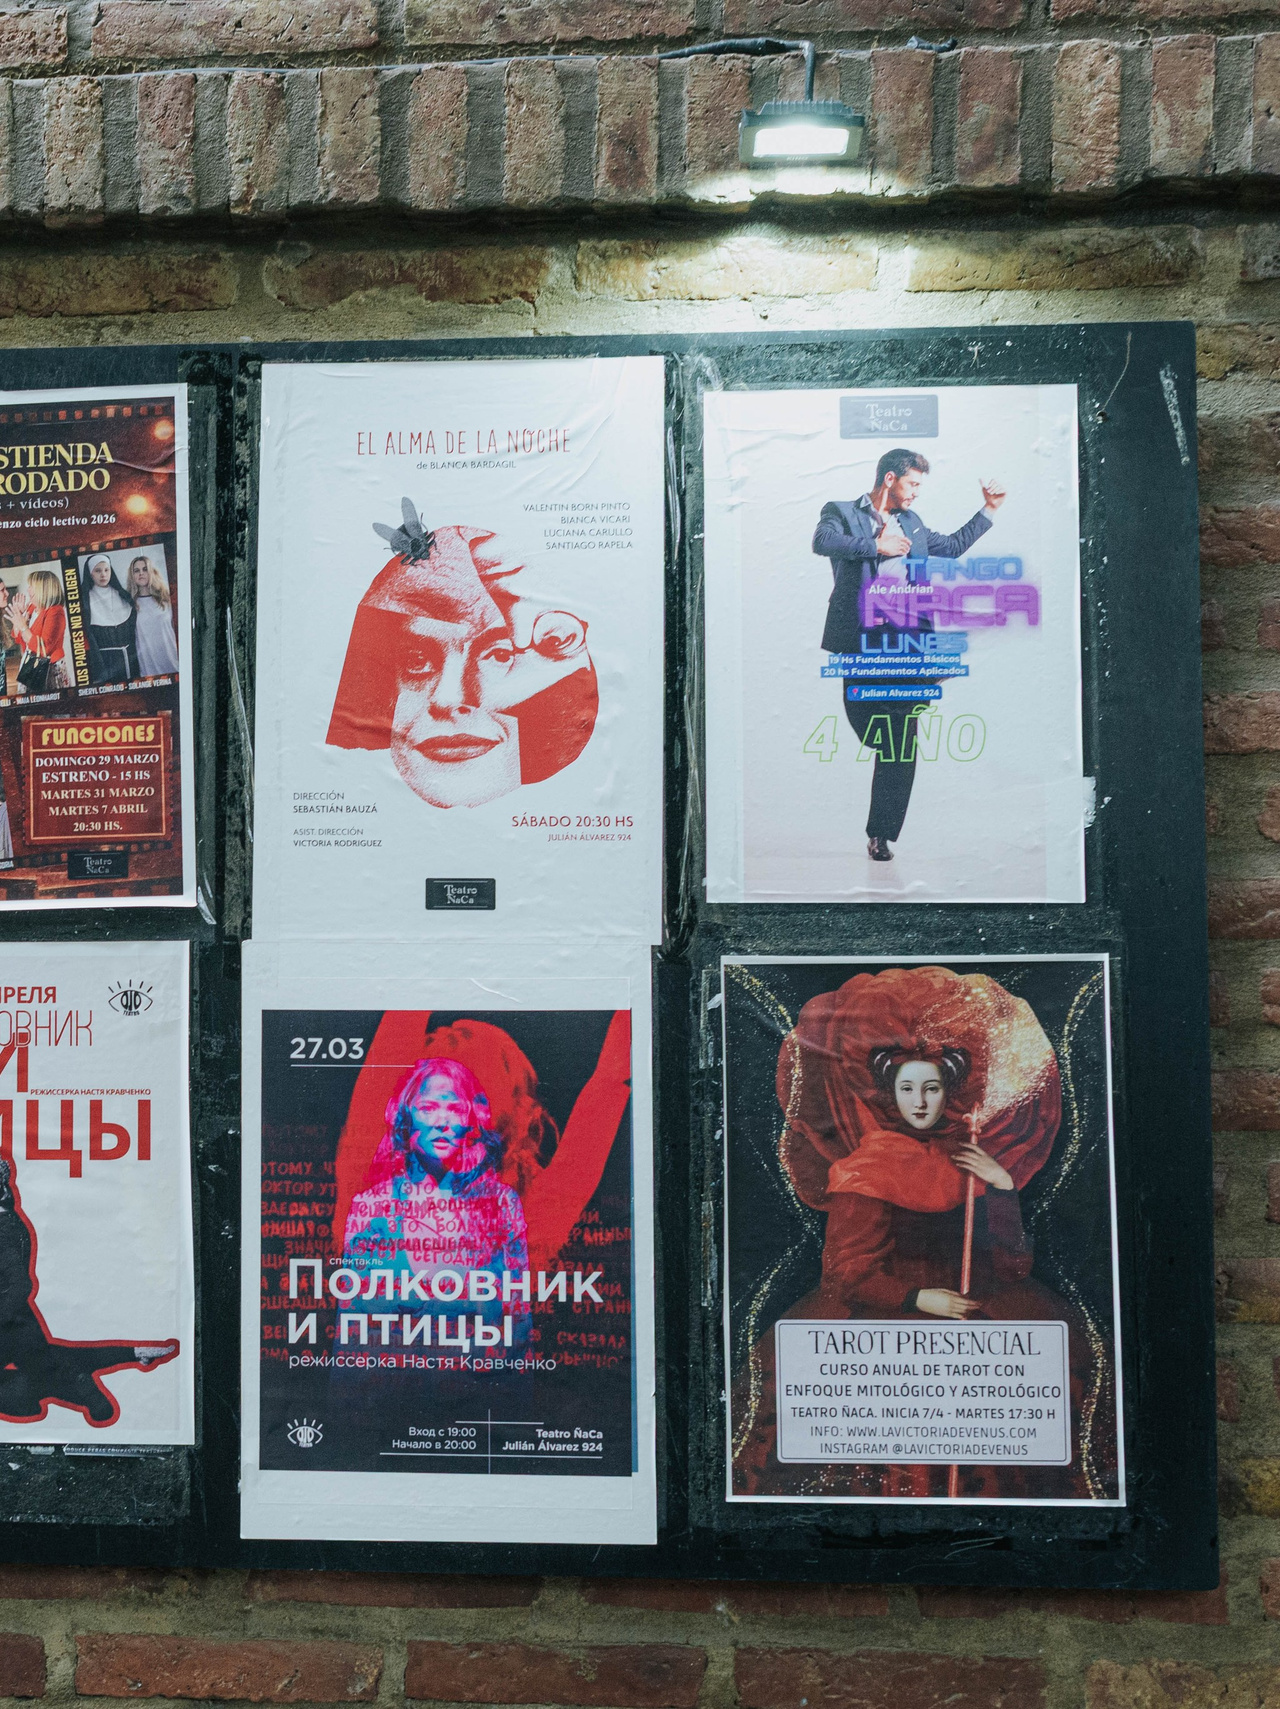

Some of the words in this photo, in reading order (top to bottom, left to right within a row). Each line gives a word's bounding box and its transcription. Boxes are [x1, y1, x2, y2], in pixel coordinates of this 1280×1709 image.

[357, 431, 376, 456] EL
[385, 431, 436, 455] ALMA
[446, 430, 466, 454] DE
[477, 429, 497, 454] LA
[508, 428, 570, 453] NOCHE
[25, 518, 50, 527] ciclo
[52, 516, 88, 527] lectivo
[90, 514, 116, 525] 2026
[599, 515, 630, 523] VICARI
[902, 557, 1022, 581] TANGO
[869, 585, 887, 594] Ale
[890, 584, 933, 594] Andrian
[861, 633, 968, 654] LUNES
[42, 724, 155, 746] FUNCIONES
[803, 716, 838, 762] 4
[856, 704, 986, 762] AÑO
[36, 755, 96, 768] DOMINGO
[113, 754, 159, 764] MARZO
[41, 789, 91, 800] MARTES
[94, 788, 106, 798] 31
[109, 787, 155, 797] MARZO
[49, 805, 99, 816] MARTES
[101, 805, 108, 814] 7
[111, 803, 148, 814] ABRIL
[293, 804, 343, 814] SEBASTIÁN
[346, 803, 377, 813] BAUZÁ
[73, 821, 101, 832] 20:30
[104, 821, 122, 831] HS.
[512, 812, 571, 828] SÁBADO
[576, 815, 611, 827] 20:30
[616, 816, 633, 827] HS
[290, 1037, 364, 1060] 27.03
[340, 1314, 512, 1353] птицы
[808, 1330, 892, 1355] TAROT
[896, 1331, 1040, 1356] PRESENCIAL
[289, 1355, 396, 1369] режиссерка
[403, 1355, 453, 1369] Настя
[460, 1355, 556, 1370] Кравченко
[820, 1364, 869, 1376] CURSO
[873, 1364, 919, 1376] ANUAL
[923, 1364, 941, 1376] DE
[944, 1364, 990, 1376] TAROT
[995, 1364, 1025, 1376] CON
[786, 1385, 852, 1398] ENFOQUE
[857, 1382, 945, 1397] MITOLÓGICO
[949, 1386, 959, 1397] Y
[962, 1383, 1061, 1398] ASTROLÓGICO
[791, 1408, 838, 1418] TEATRO
[882, 1408, 919, 1419] INICIA
[922, 1408, 943, 1420] 7/4
[956, 1408, 1004, 1419] MARTES
[1009, 1409, 1043, 1419] 17:30
[1047, 1409, 1055, 1419] H
[409, 1427, 436, 1437] Вход
[447, 1427, 476, 1437] 19:00
[536, 1429, 570, 1439] Teatro
[574, 1427, 603, 1439] ÑaCa
[810, 1426, 843, 1437] INFO:
[847, 1426, 1037, 1439] WWW.LAVICTORIADEVENUS.COM
[392, 1440, 432, 1450] Начало
[444, 1441, 476, 1450] 20:00
[820, 1443, 888, 1454] INSTAGRAM
[892, 1444, 1028, 1456] @LAVICTORIADEVENUS
